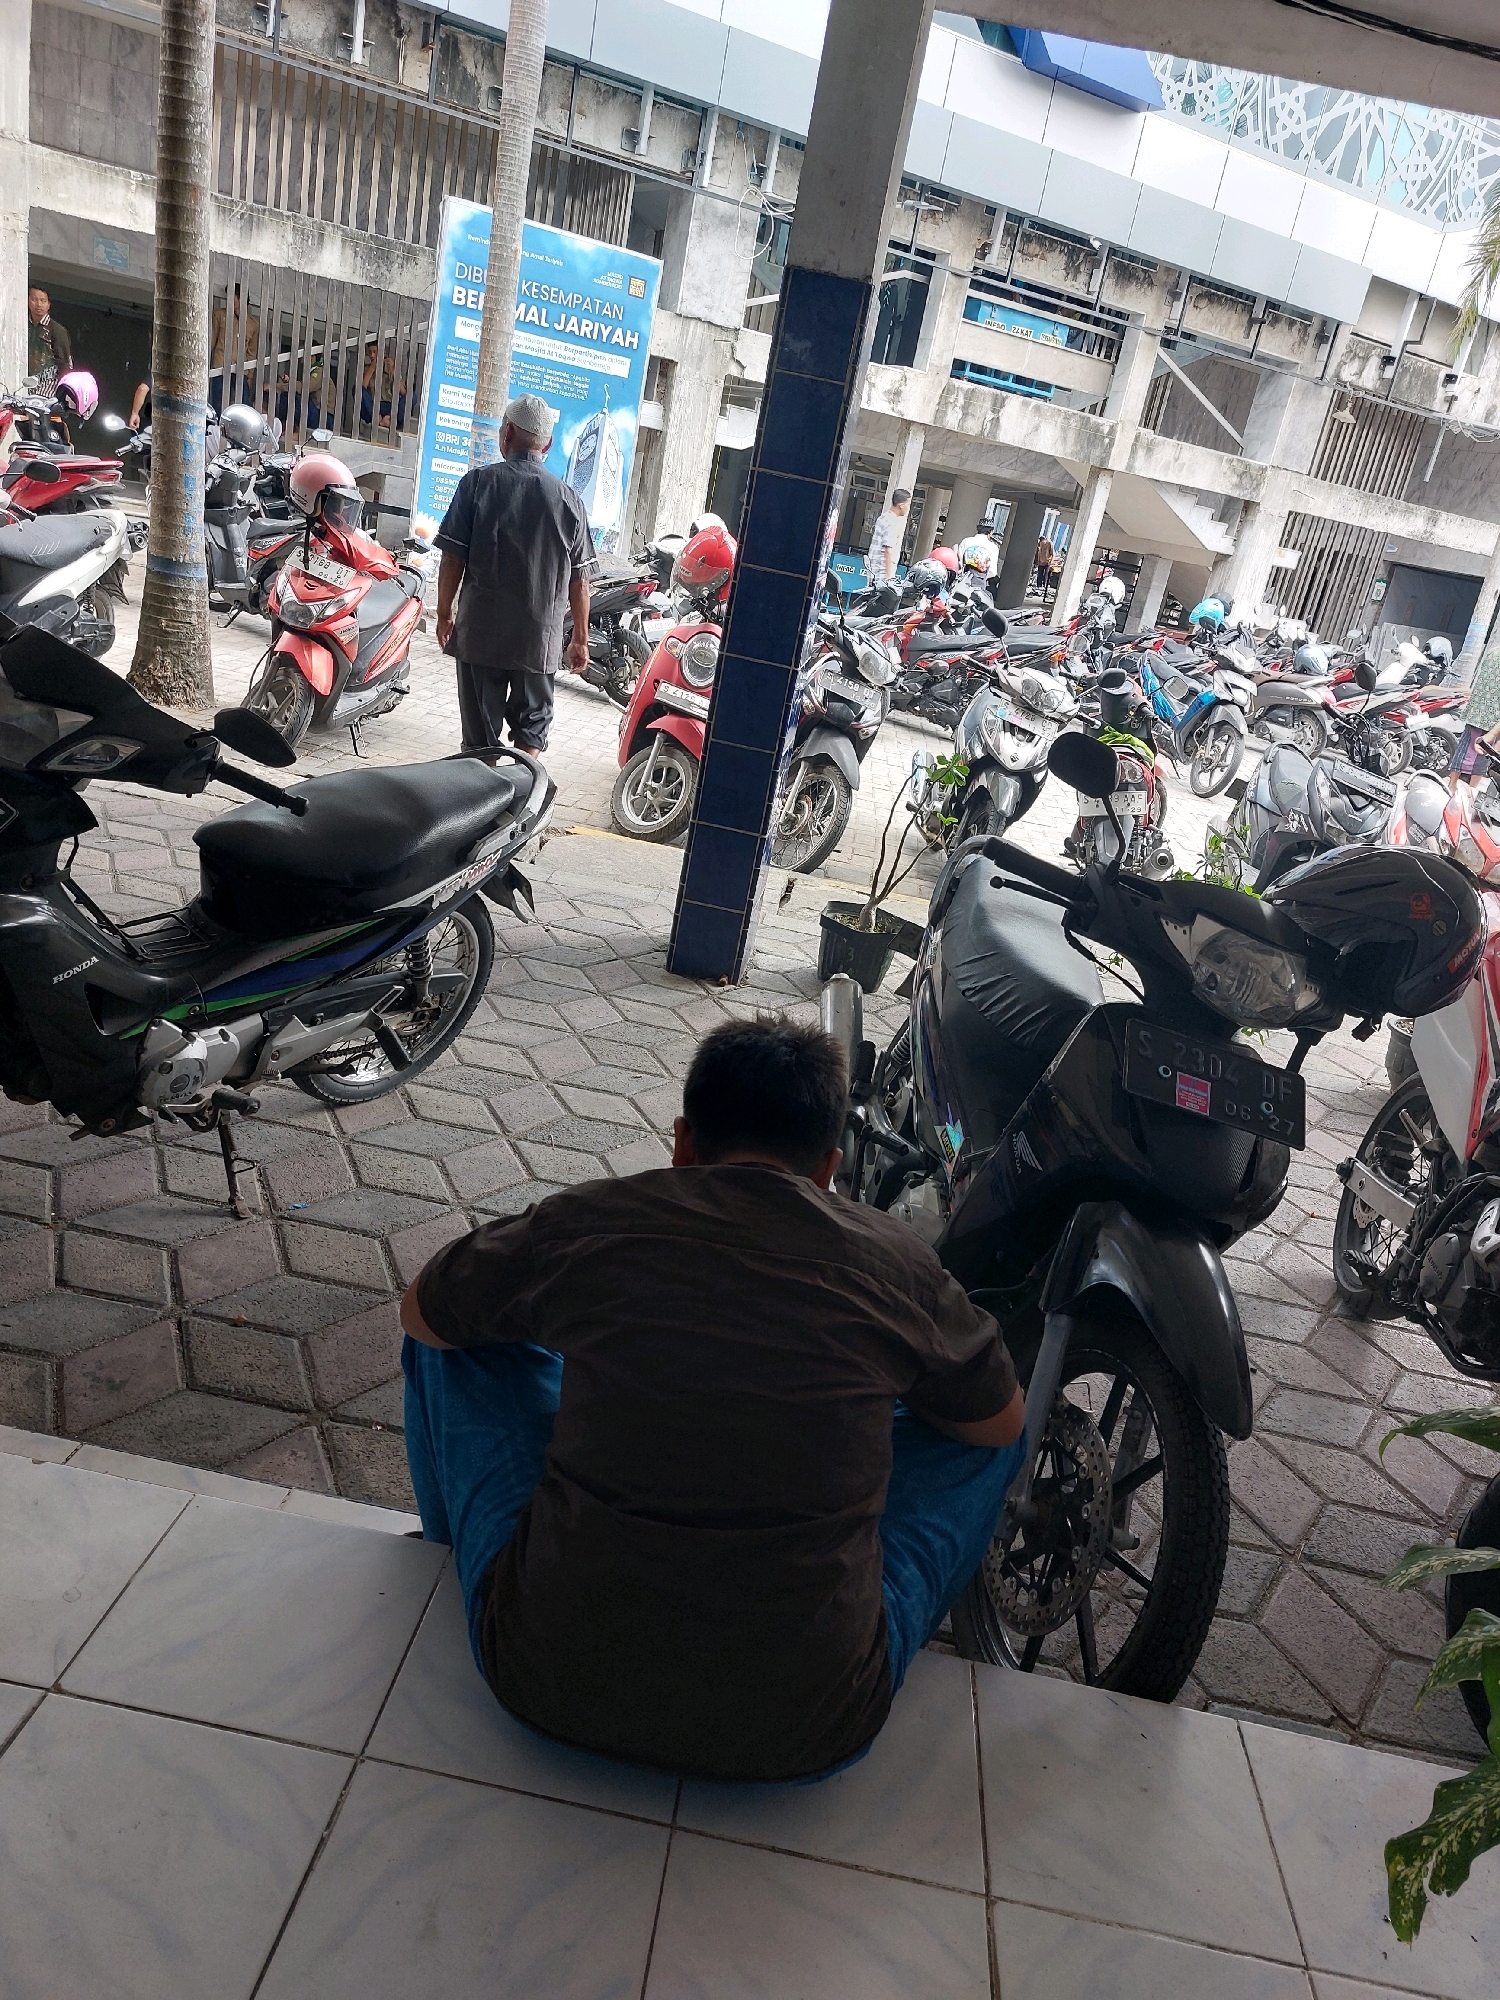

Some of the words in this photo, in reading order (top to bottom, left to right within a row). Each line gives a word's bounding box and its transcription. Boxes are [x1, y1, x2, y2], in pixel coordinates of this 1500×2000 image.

[521, 279, 624, 321] KESEMPATAN
[554, 313, 639, 350] JARIYAH
[1012, 326, 1032, 338] ZAKAT
[445, 432, 459, 445] BRI
[53, 956, 99, 985] HONDA
[1138, 1030, 1153, 1059] S
[1012, 1132, 1022, 1174] HONDA
